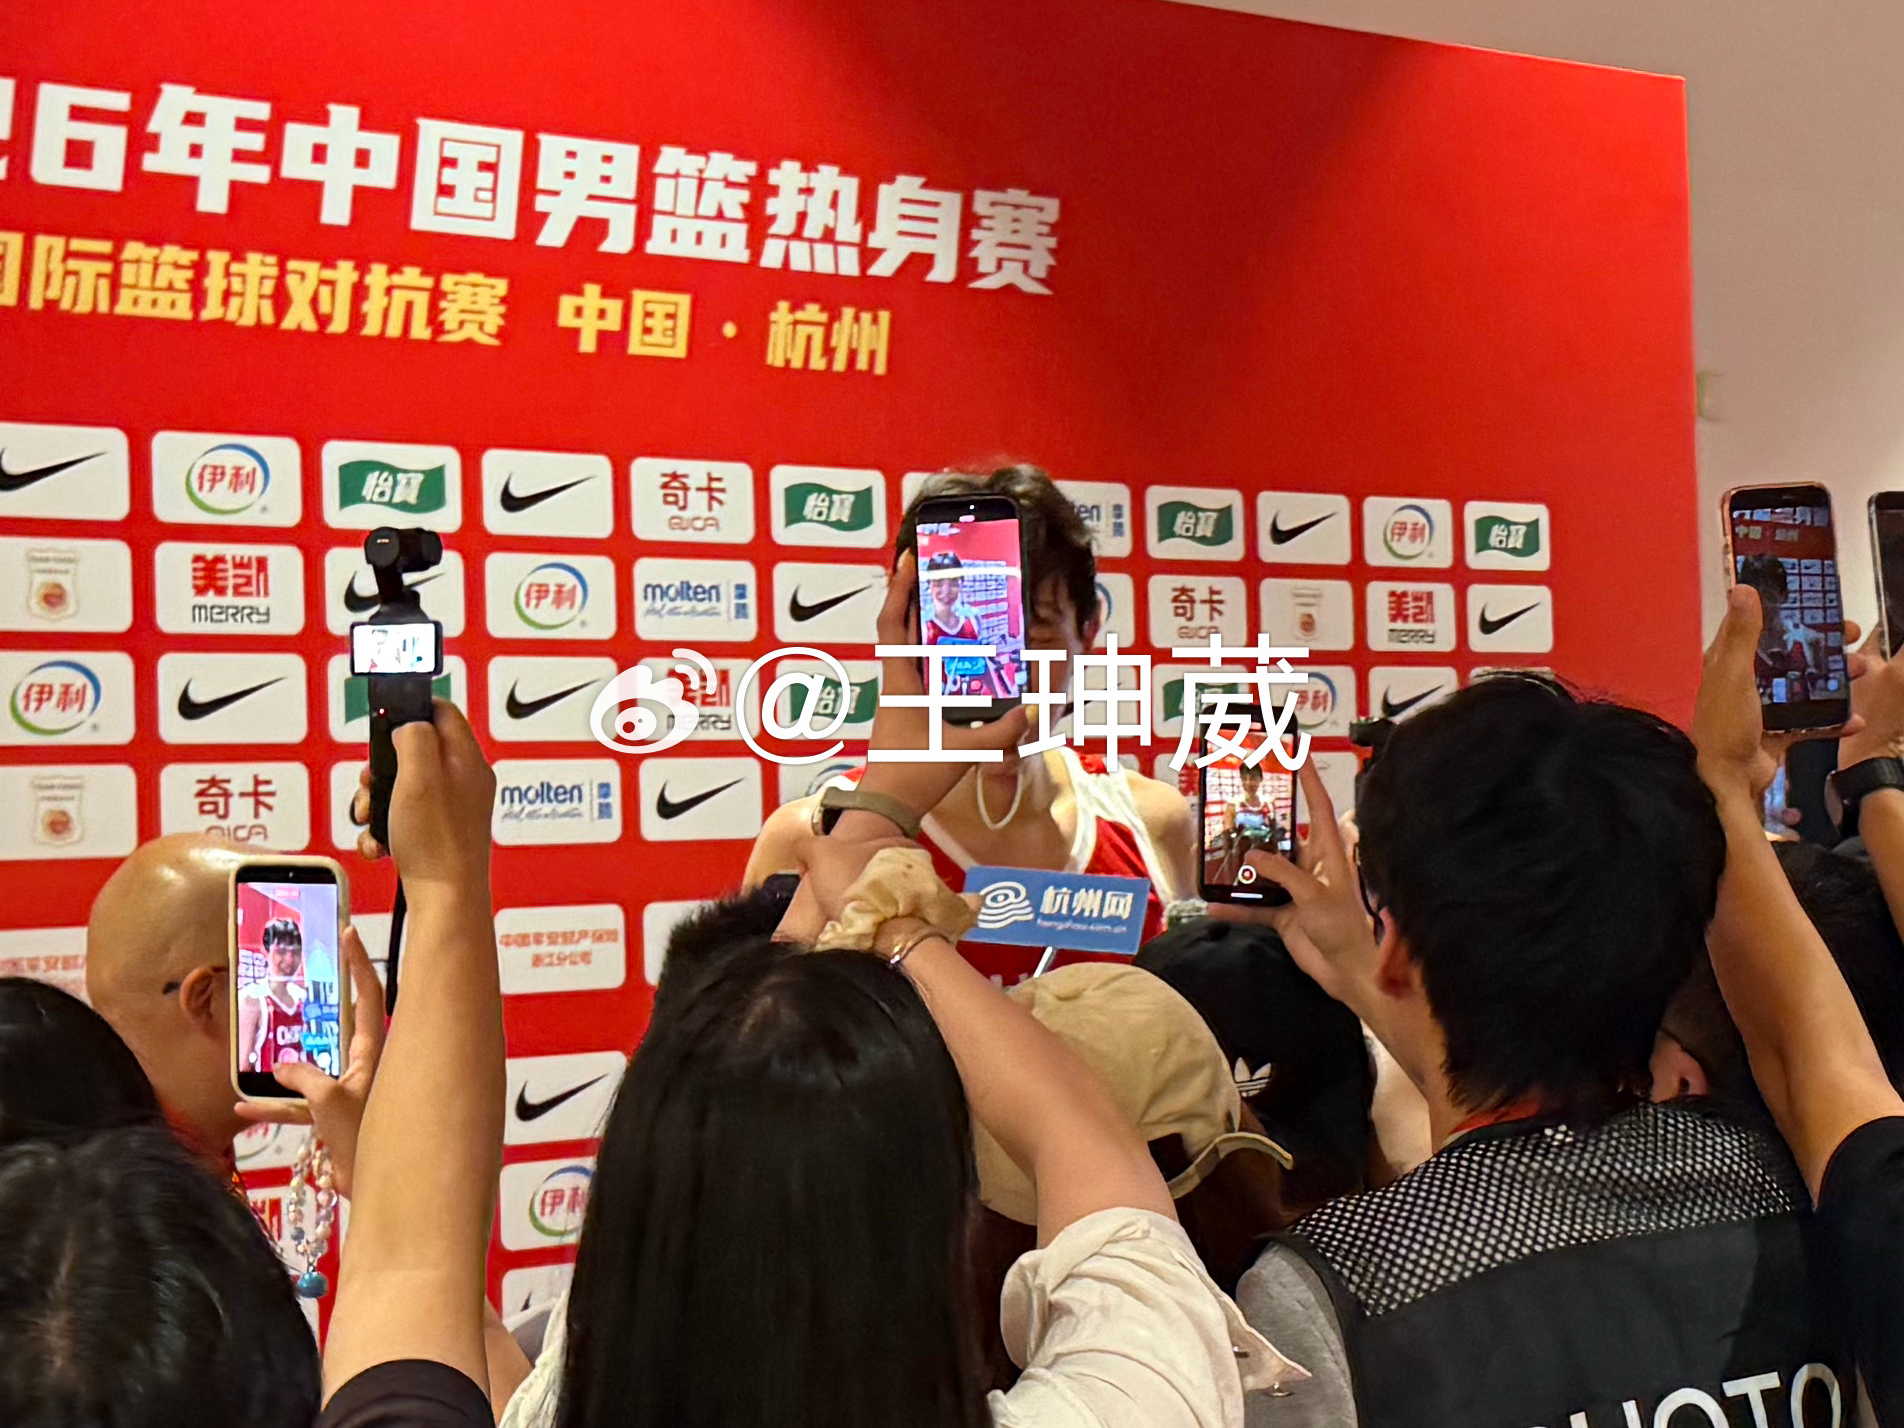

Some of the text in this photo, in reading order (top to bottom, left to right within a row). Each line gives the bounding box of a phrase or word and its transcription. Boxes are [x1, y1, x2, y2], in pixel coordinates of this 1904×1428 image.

[198, 464, 256, 494] 伊利
[659, 471, 726, 513] 奇卡
[191, 554, 269, 597] 美凯
[643, 581, 721, 603] molten
[525, 583, 576, 609] 伊利
[1171, 586, 1225, 622] 奇卡
[23, 682, 86, 713] 伊利
[194, 774, 277, 820] 奇卡
[501, 781, 583, 805] molten
[1039, 885, 1133, 920] 杭州网
